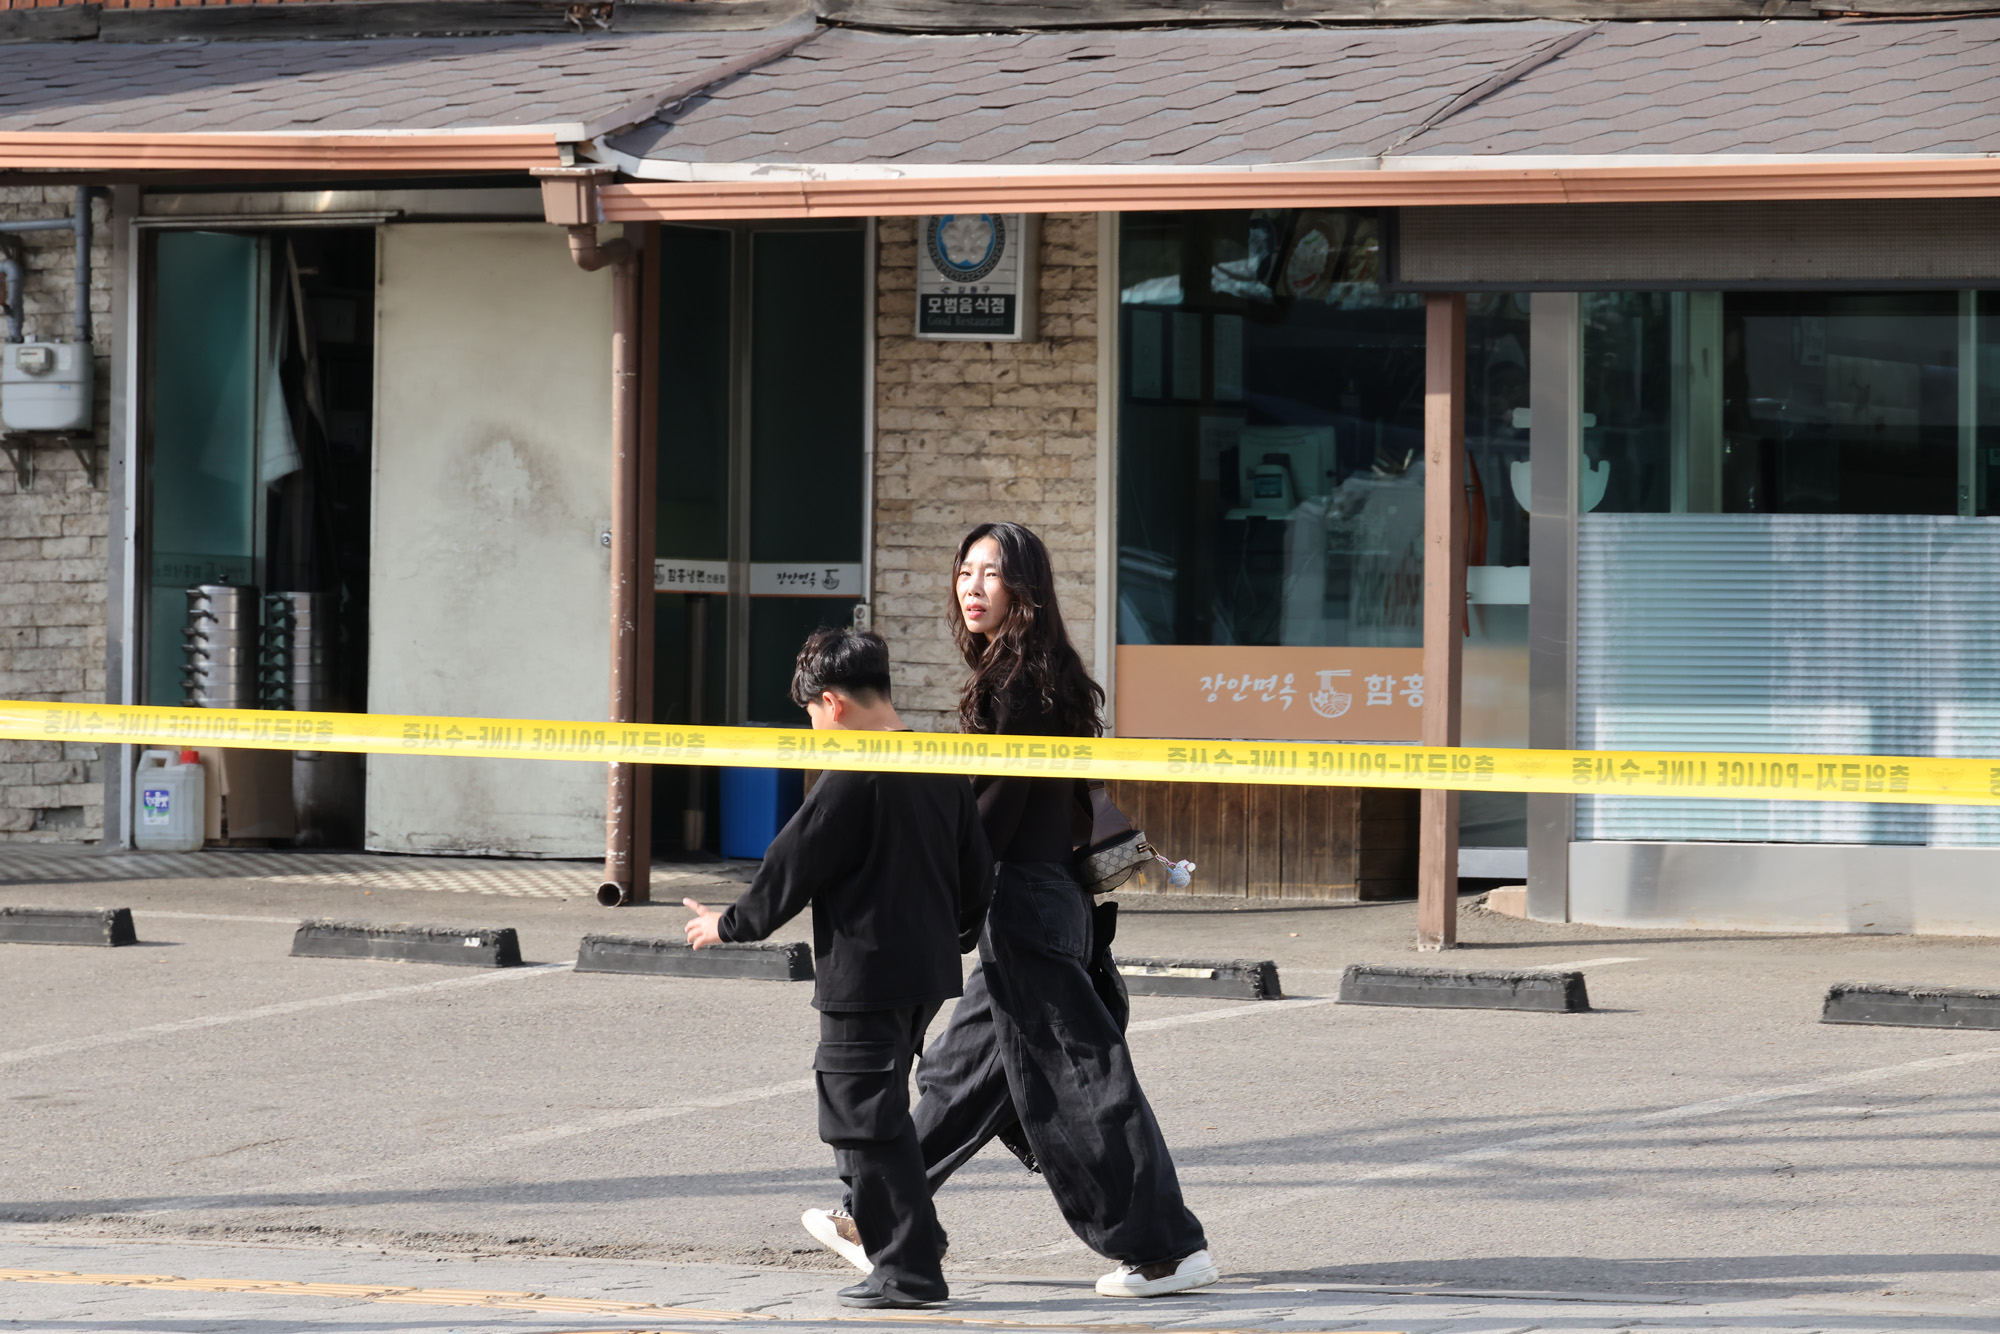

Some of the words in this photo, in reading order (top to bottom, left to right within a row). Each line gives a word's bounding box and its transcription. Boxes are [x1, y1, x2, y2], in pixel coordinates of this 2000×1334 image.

[928, 297, 1005, 314] 모범음식점
[776, 571, 817, 588] 장안면옥
[1199, 673, 1298, 711] 장안면옥
